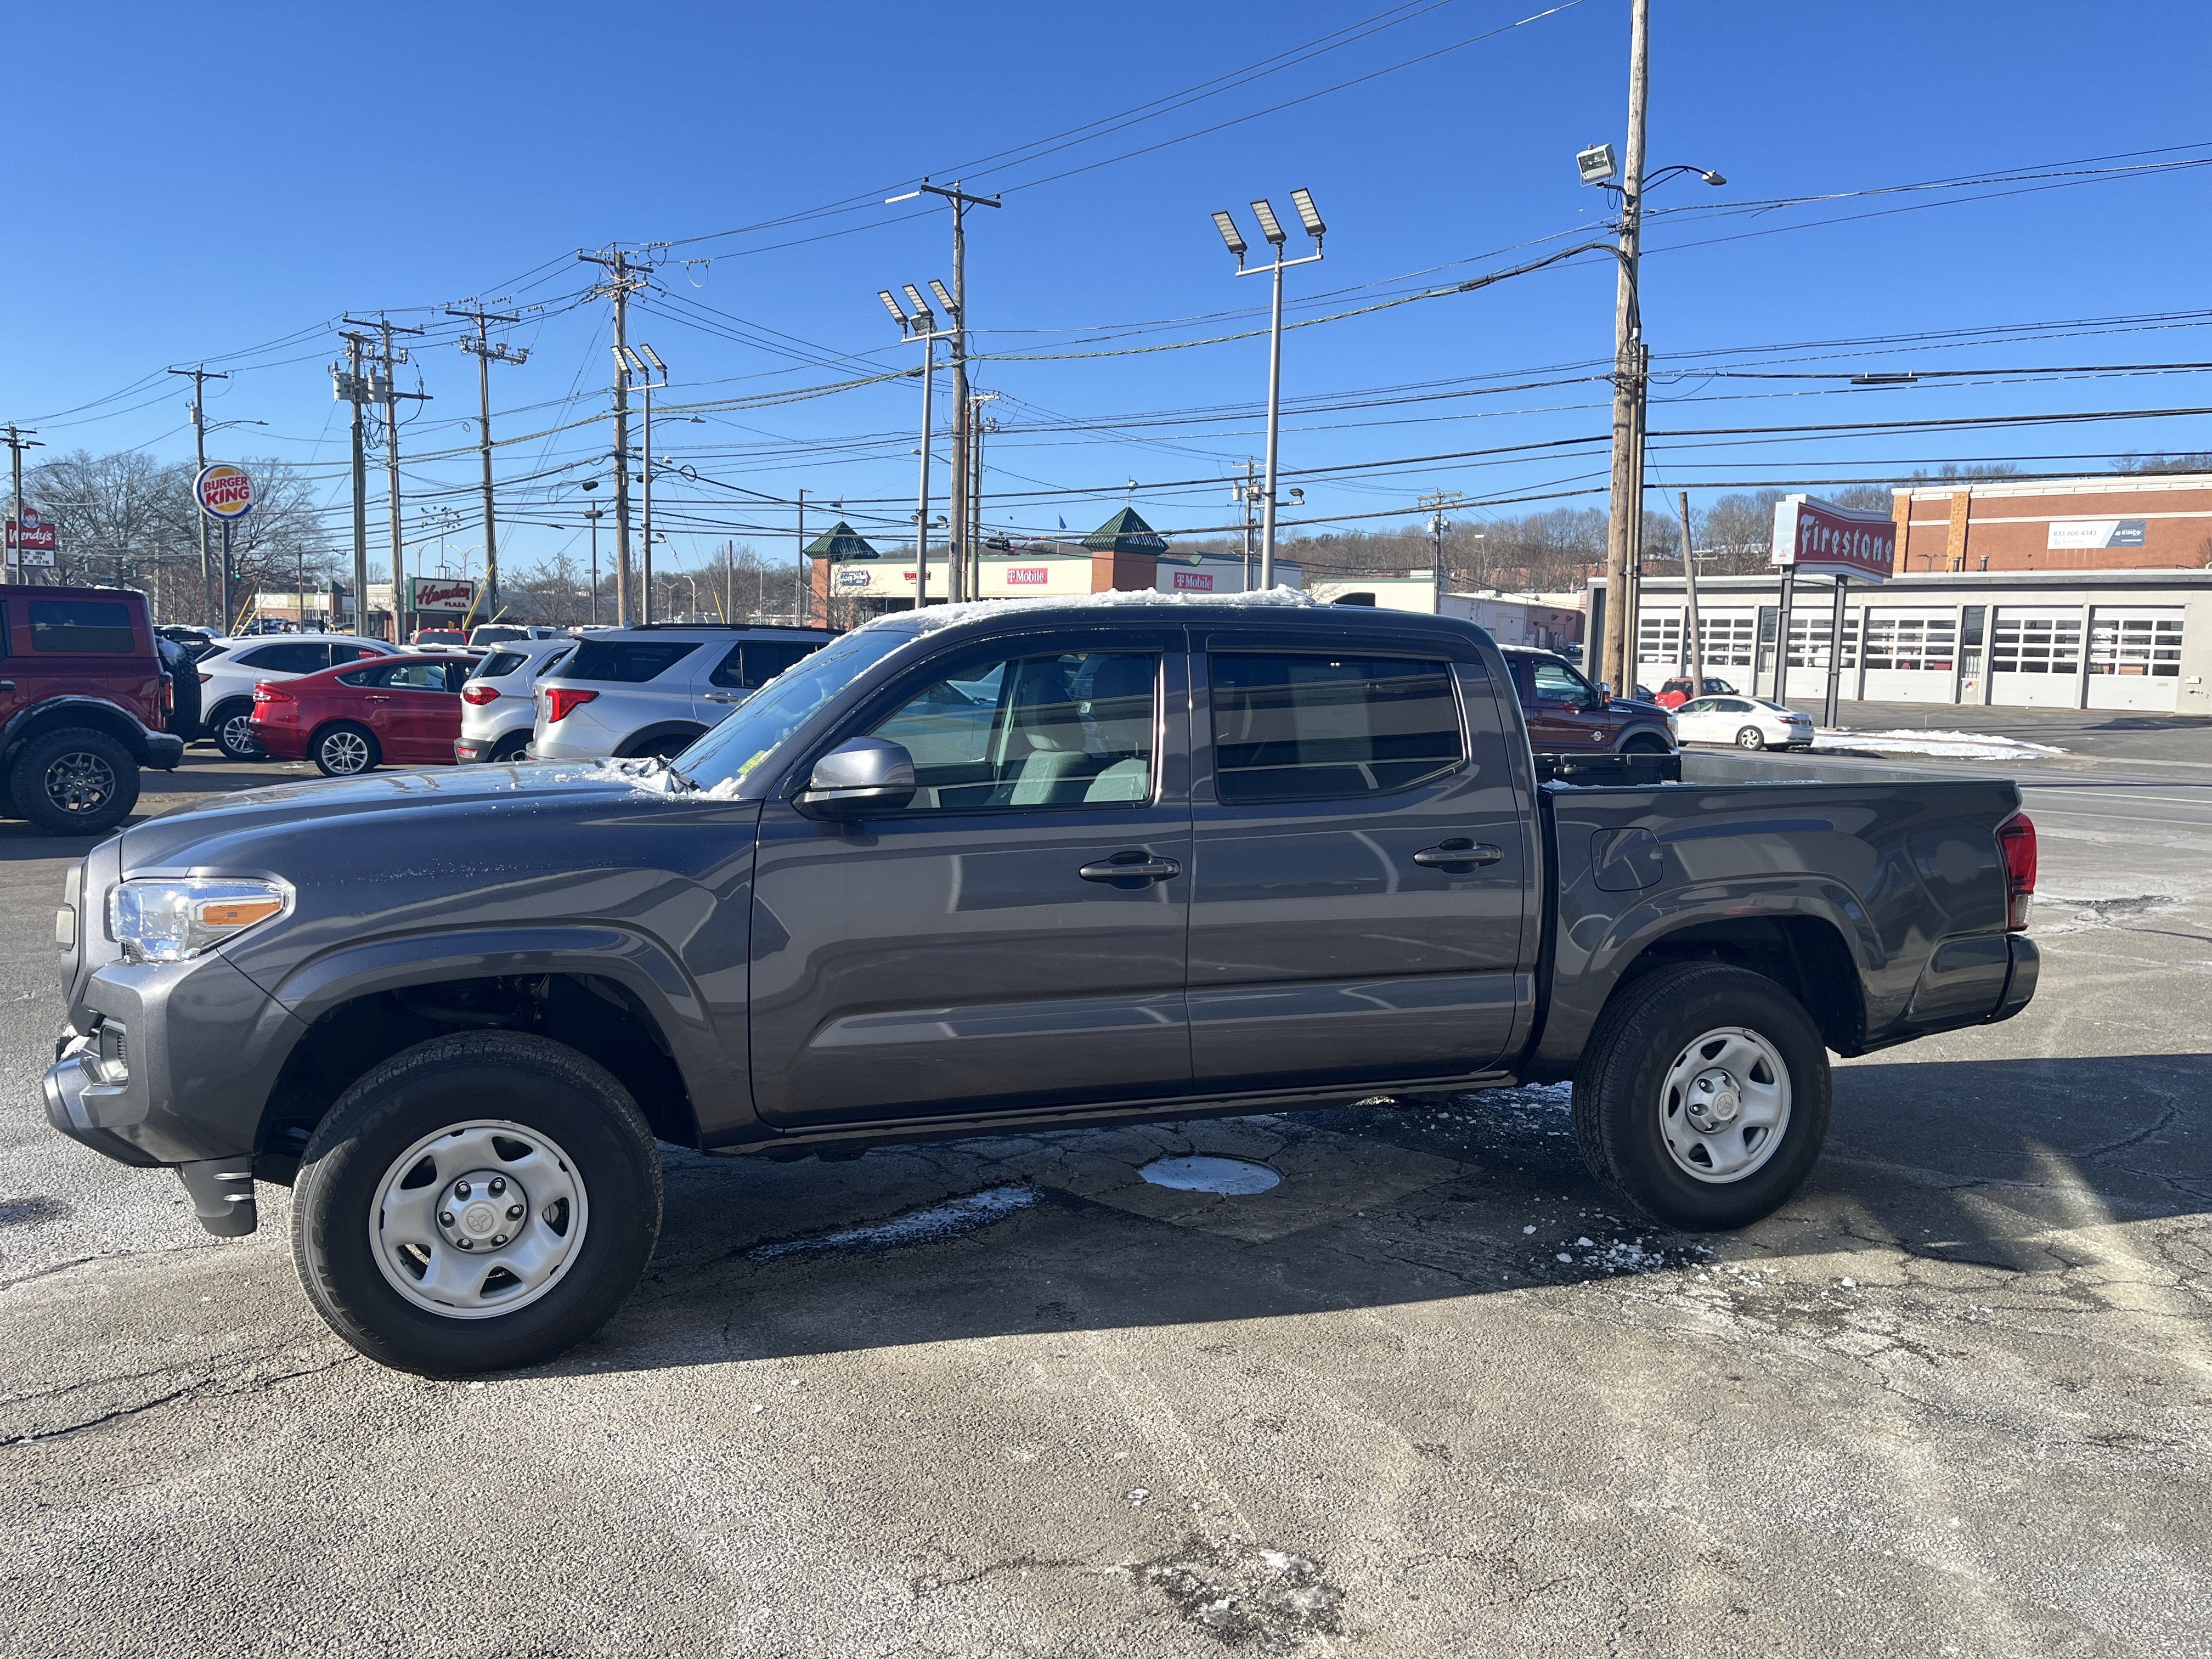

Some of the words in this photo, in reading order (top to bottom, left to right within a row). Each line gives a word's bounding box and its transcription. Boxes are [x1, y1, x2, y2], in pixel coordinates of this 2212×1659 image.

[204, 477, 248, 493] BURGER
[206, 486, 250, 507] KING
[9, 528, 52, 544] Wendy's
[1799, 514, 1893, 563] Firestone
[1017, 570, 1045, 582] Mobile
[1185, 575, 1212, 589] Mobile
[416, 583, 470, 605] Hamden
